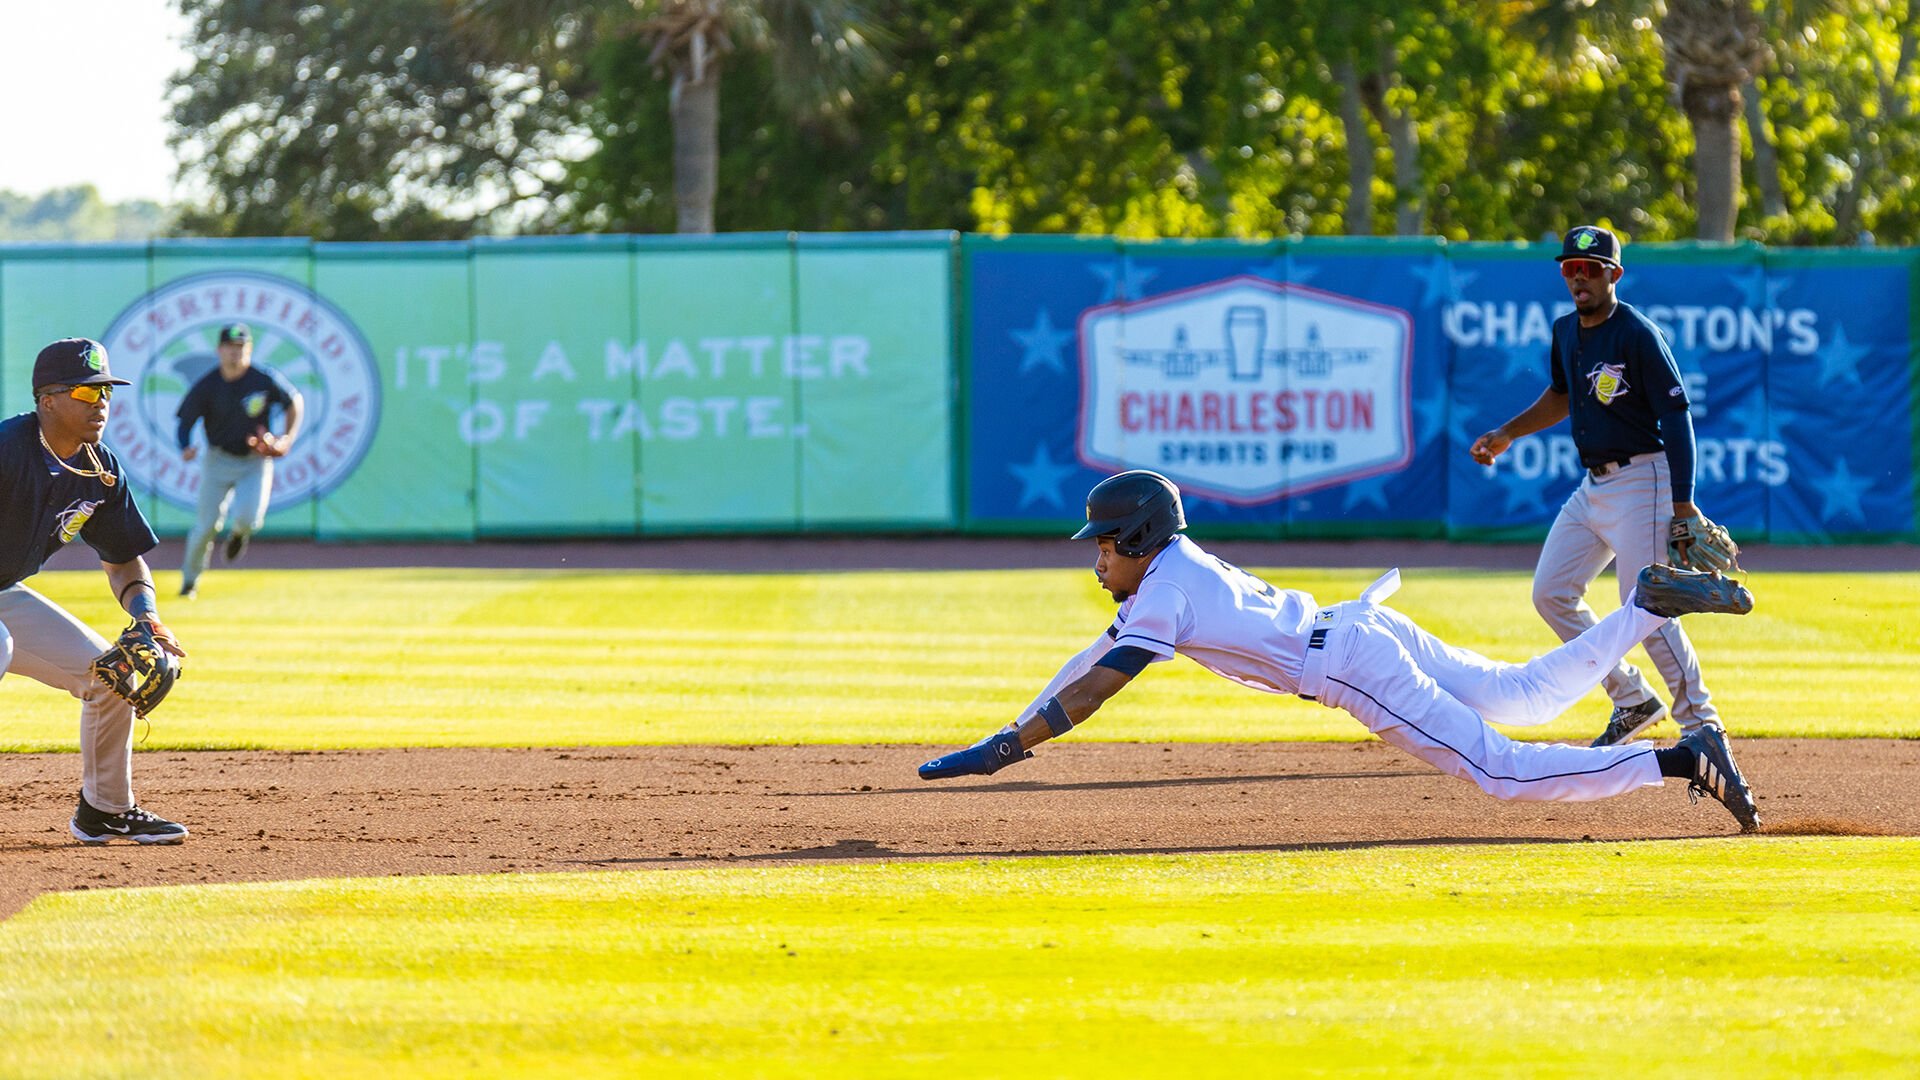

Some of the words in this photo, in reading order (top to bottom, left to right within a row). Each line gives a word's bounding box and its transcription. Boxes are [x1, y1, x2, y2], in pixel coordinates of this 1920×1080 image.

[124, 287, 346, 359] CERTIFIED
[1442, 301, 1820, 355] CHASTON'S
[395, 341, 506, 389] IT'S
[532, 340, 578, 382] A
[604, 335, 870, 380] MATTER
[459, 400, 549, 444] OF
[577, 396, 810, 440] TASTE.
[1119, 390, 1375, 432] CHARLESTON
[1160, 440, 1267, 464] SPORTS
[1280, 438, 1337, 463] PUB
